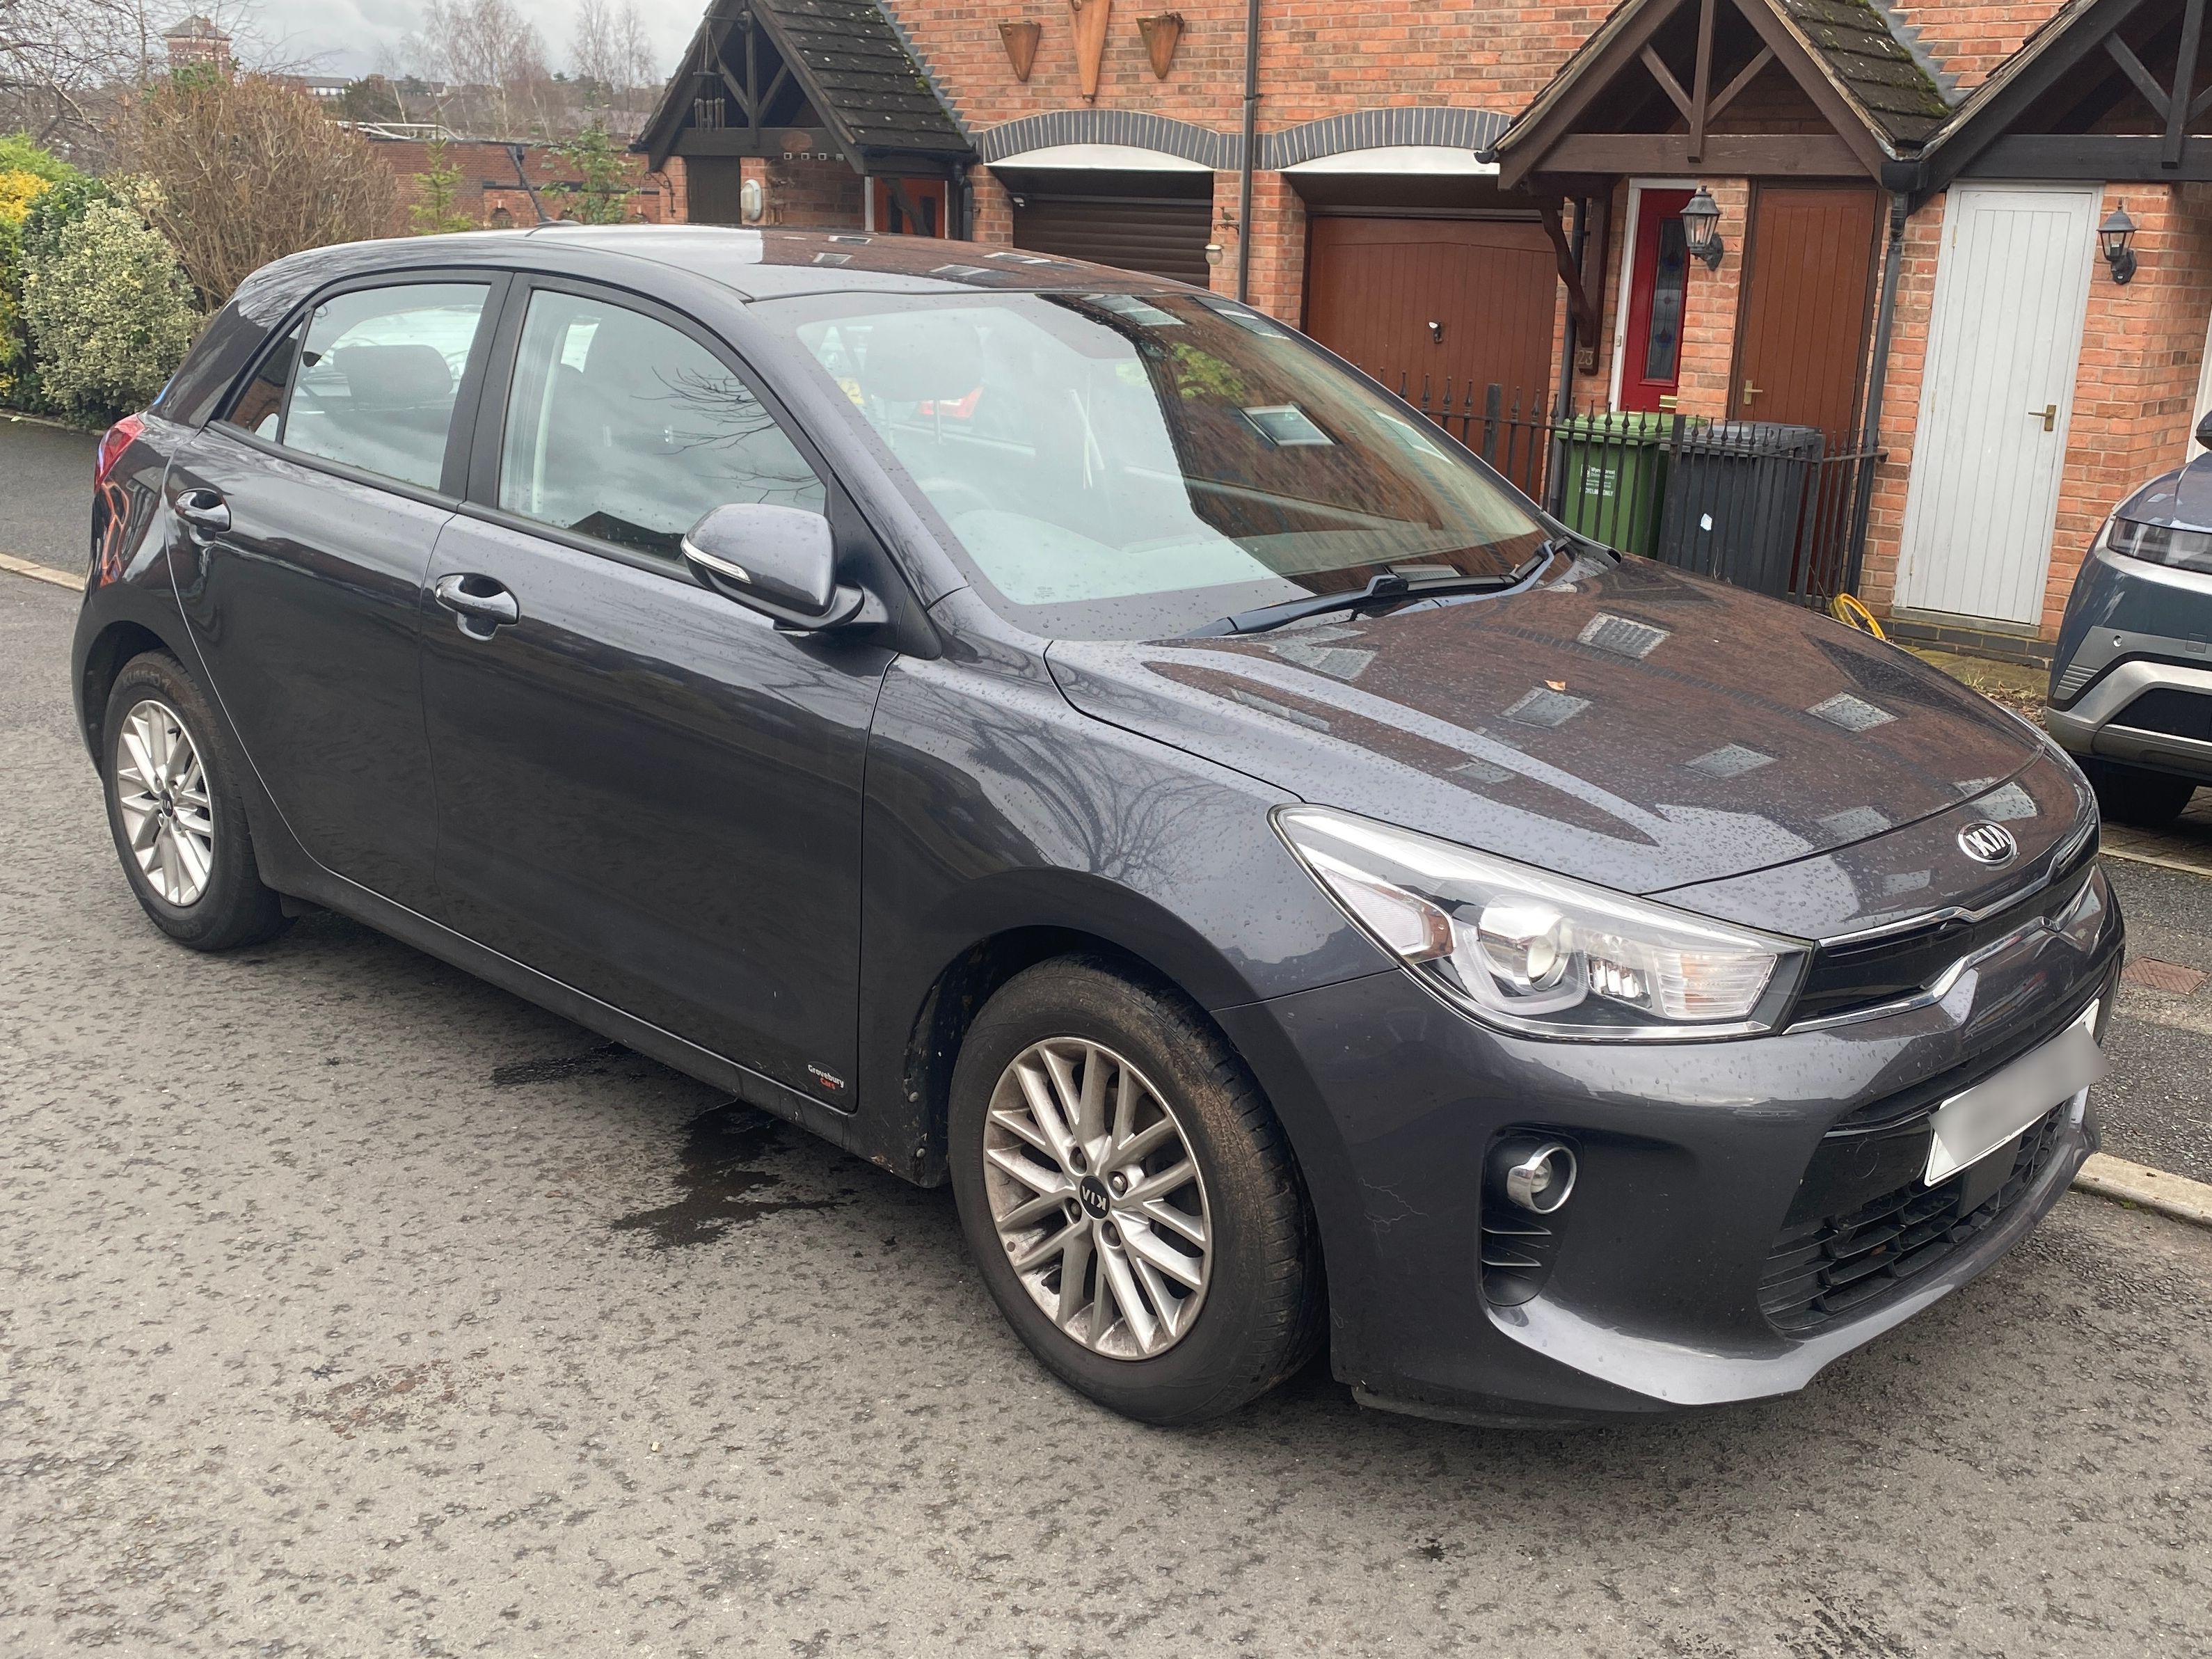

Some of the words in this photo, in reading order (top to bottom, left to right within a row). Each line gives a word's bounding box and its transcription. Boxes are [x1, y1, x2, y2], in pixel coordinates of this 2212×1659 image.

[1578, 350, 1593, 365] 23
[1966, 825, 2011, 857] KIA
[808, 1064, 844, 1088] Grovebury
[1081, 1185, 1106, 1211] KIA
